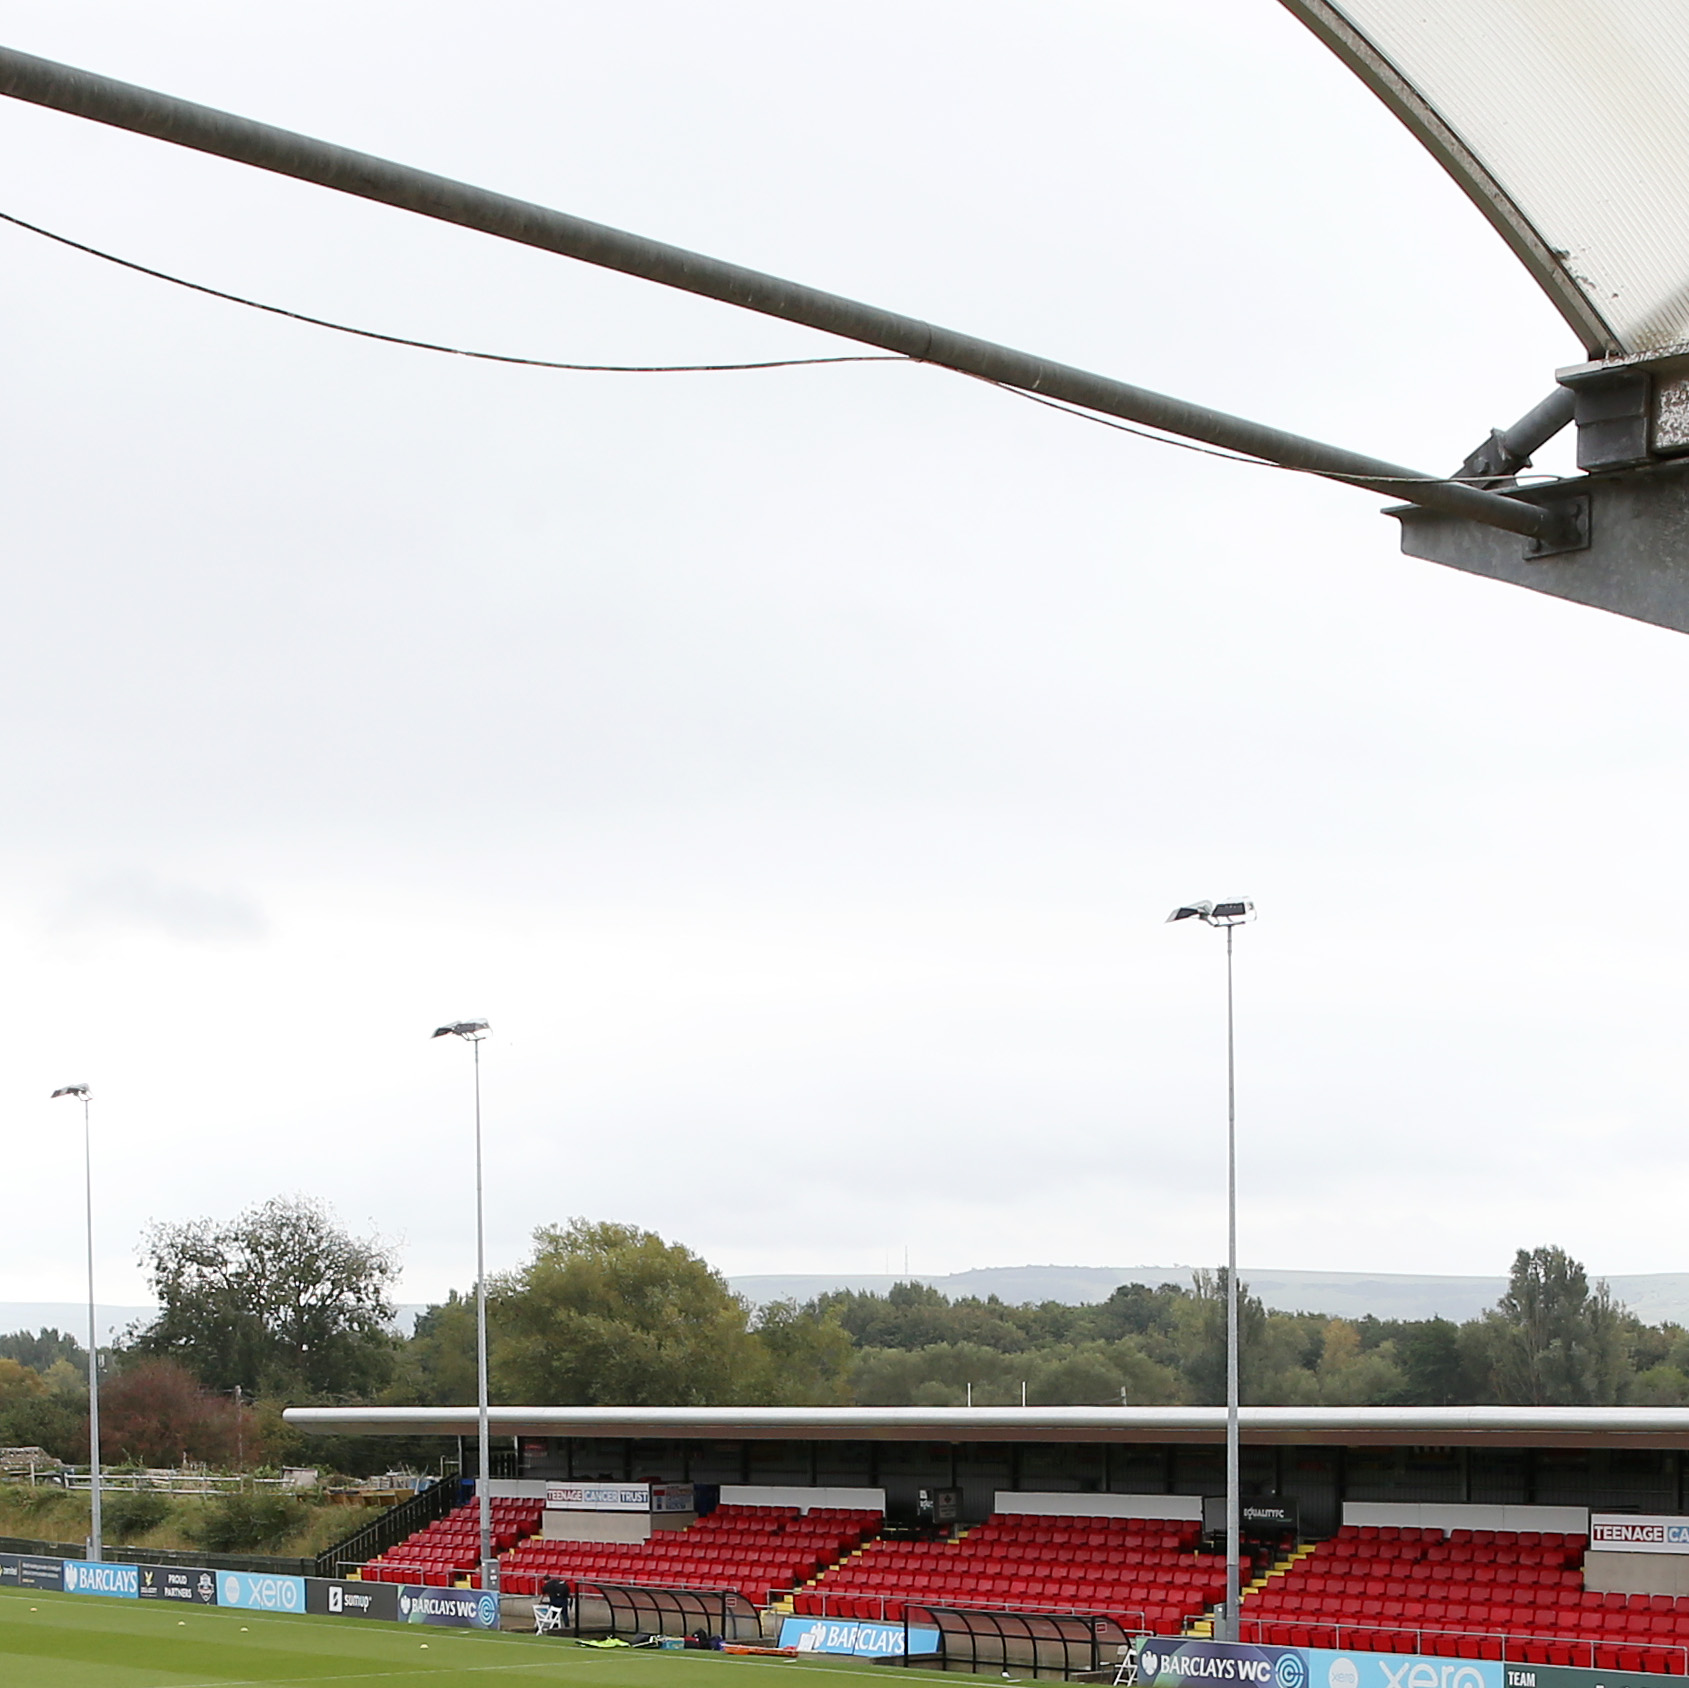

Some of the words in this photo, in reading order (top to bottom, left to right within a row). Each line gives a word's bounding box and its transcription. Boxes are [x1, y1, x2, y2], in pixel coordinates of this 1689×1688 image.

[547, 1489, 582, 1501] TEENAGE
[584, 1490, 618, 1502] CANCER
[620, 1491, 648, 1503] TRUST
[1594, 1524, 1663, 1542] TEENAGE
[79, 1567, 137, 1593] BARCLAYS
[248, 1578, 297, 1609] xero
[412, 1597, 455, 1616] BARCLAYS
[457, 1601, 477, 1618] WC
[827, 1626, 905, 1653] BARCLAYS
[1160, 1655, 1235, 1679] BARCLAYS
[1237, 1659, 1271, 1682] WC
[1507, 1671, 1535, 1687] TEAM
